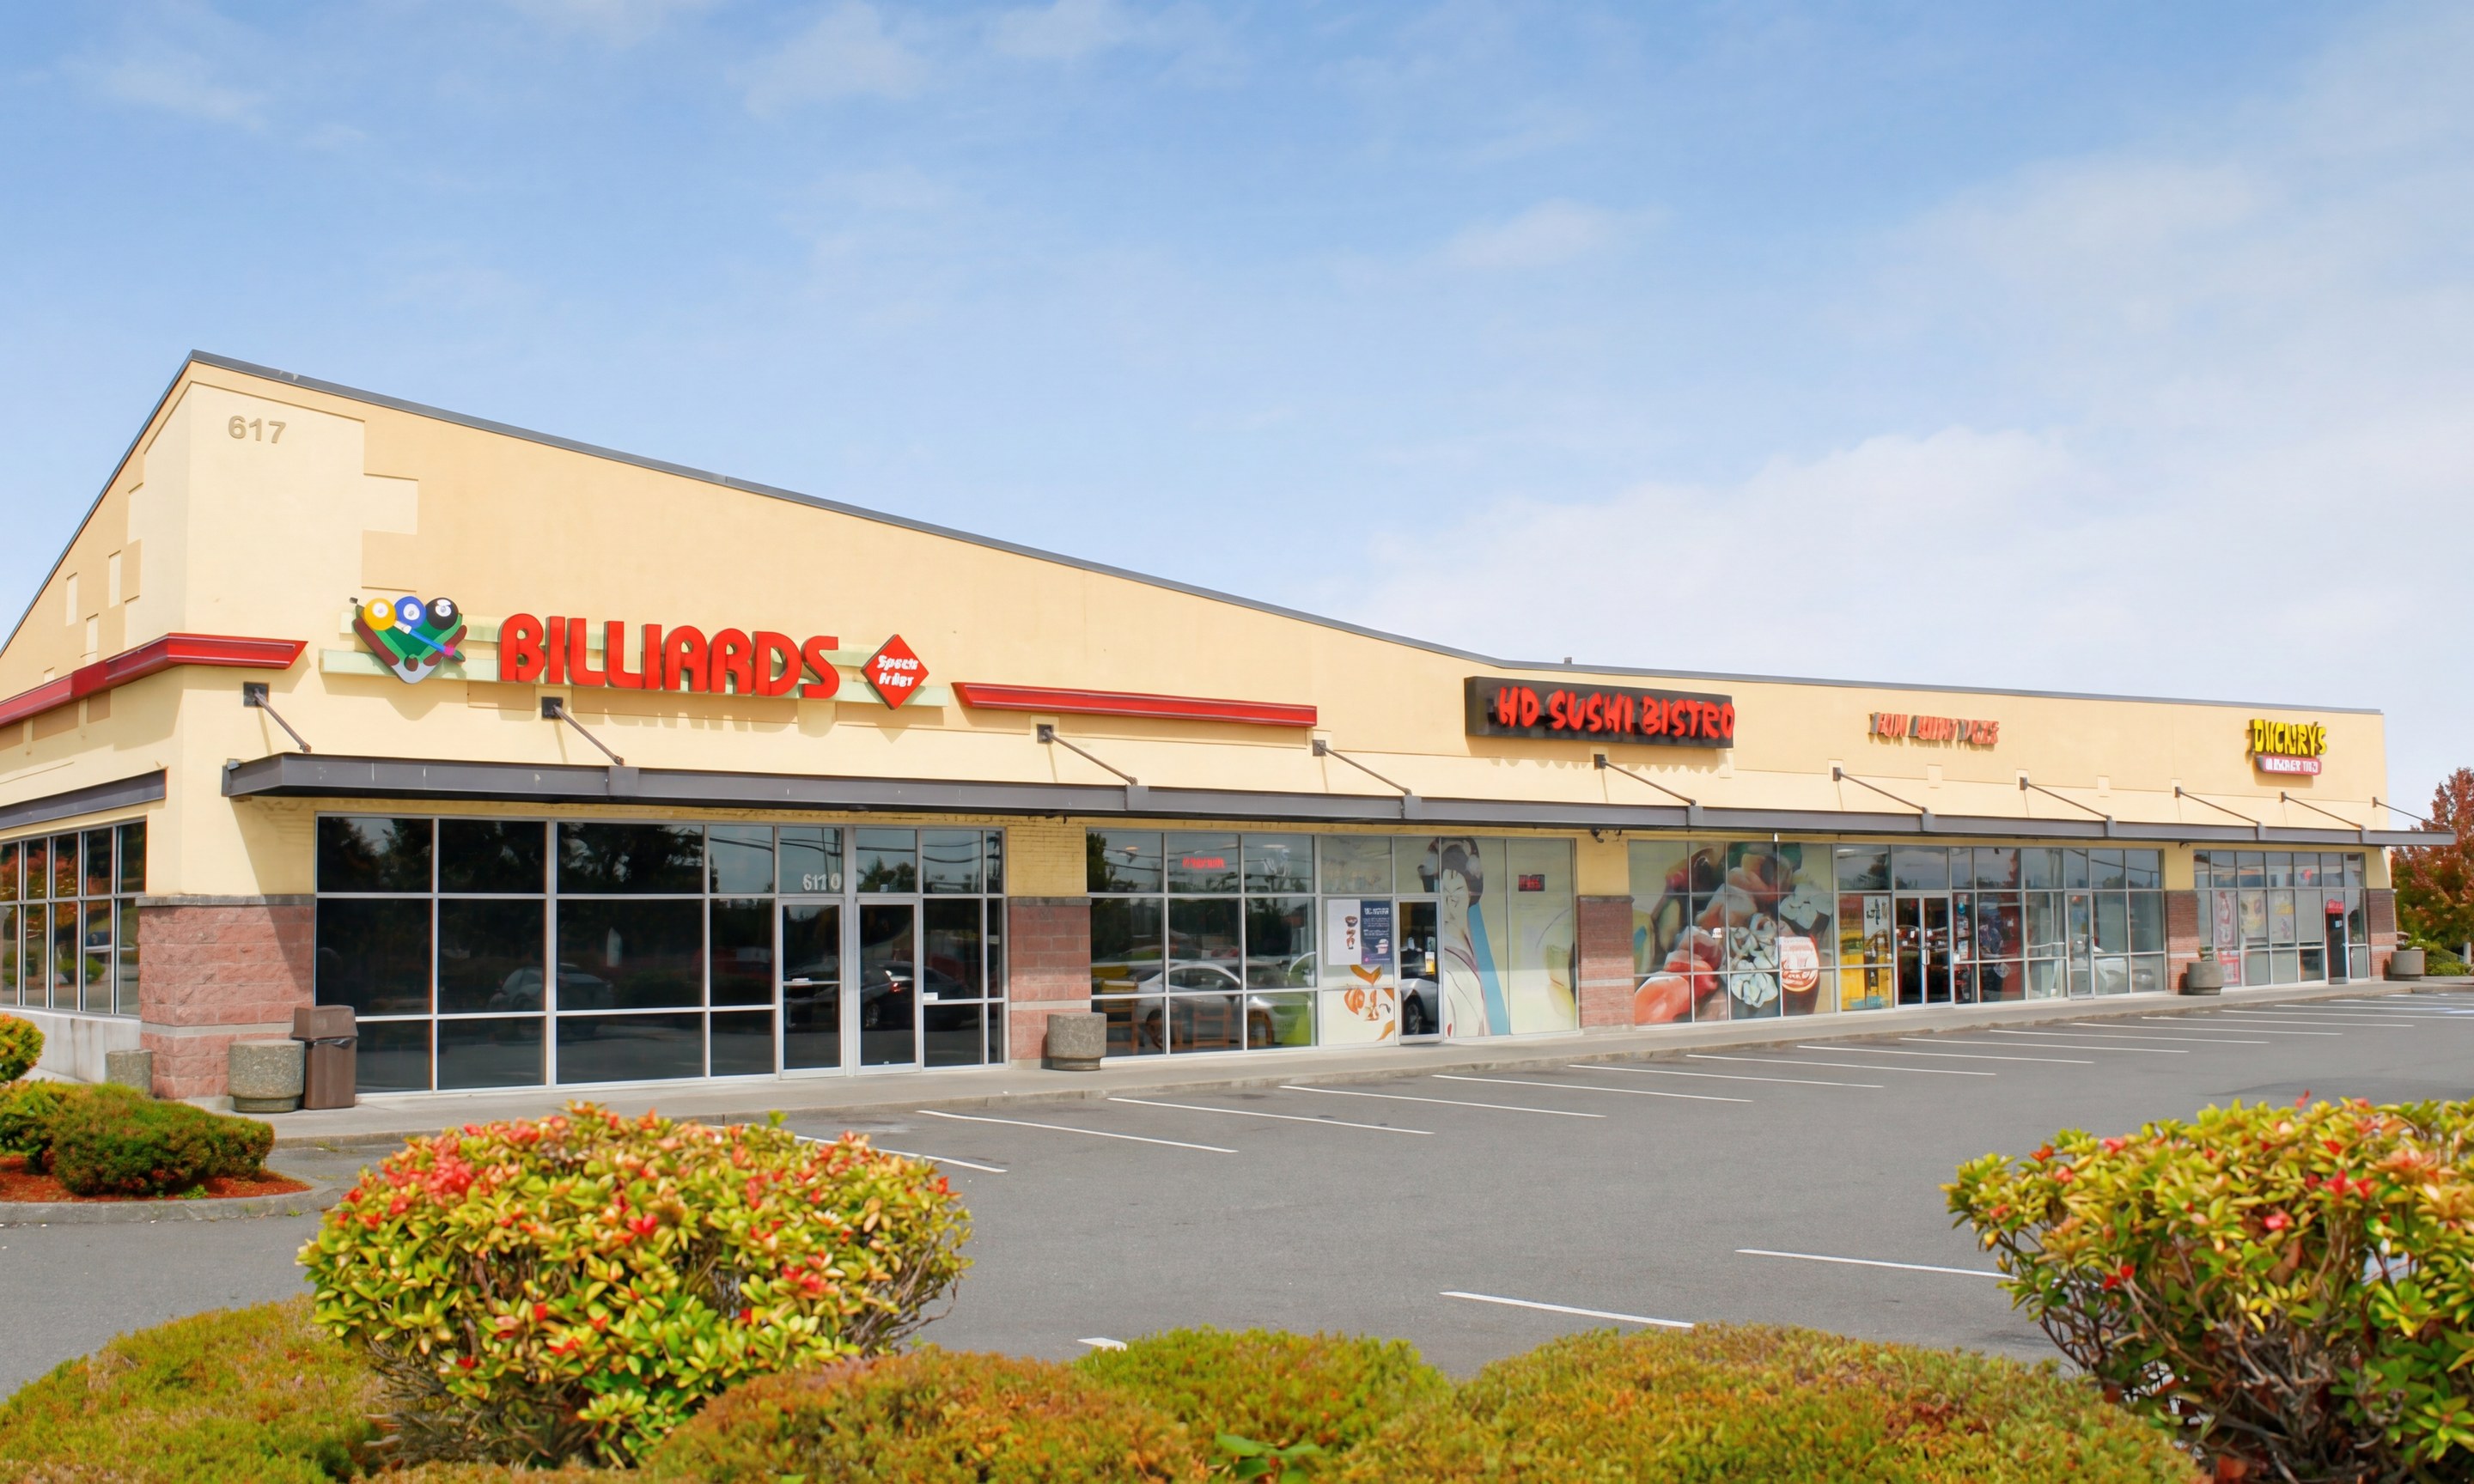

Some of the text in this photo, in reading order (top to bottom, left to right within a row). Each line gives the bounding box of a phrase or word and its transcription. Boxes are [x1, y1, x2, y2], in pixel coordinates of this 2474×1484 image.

[229, 415, 286, 444] 617
[497, 613, 839, 699] BILLIARDS
[1497, 686, 1735, 739] HD SUSHI BISTRO
